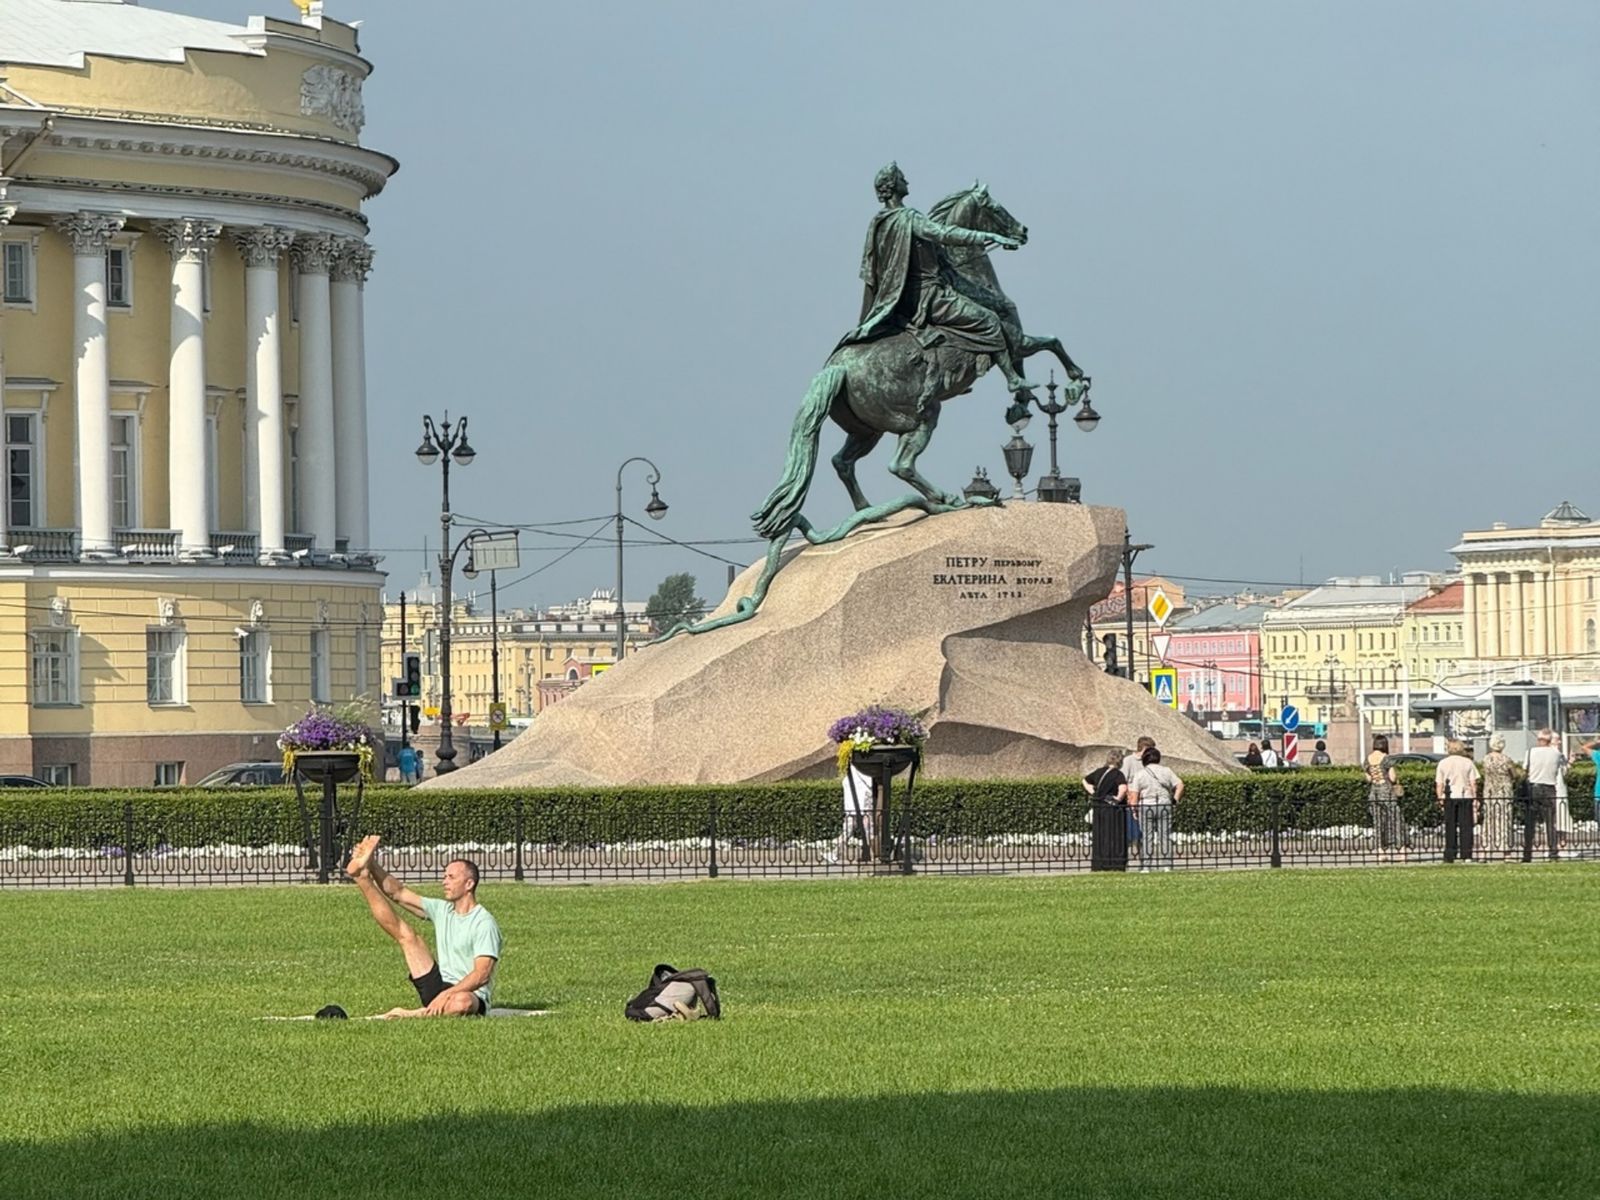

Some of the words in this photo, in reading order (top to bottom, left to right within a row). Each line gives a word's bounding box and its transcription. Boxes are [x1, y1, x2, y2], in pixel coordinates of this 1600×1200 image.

[946, 557, 988, 568] ПЕТРУ
[933, 574, 1008, 585] ЕКАТЕРИНА
[1017, 577, 1053, 585] ВТОРАЯ
